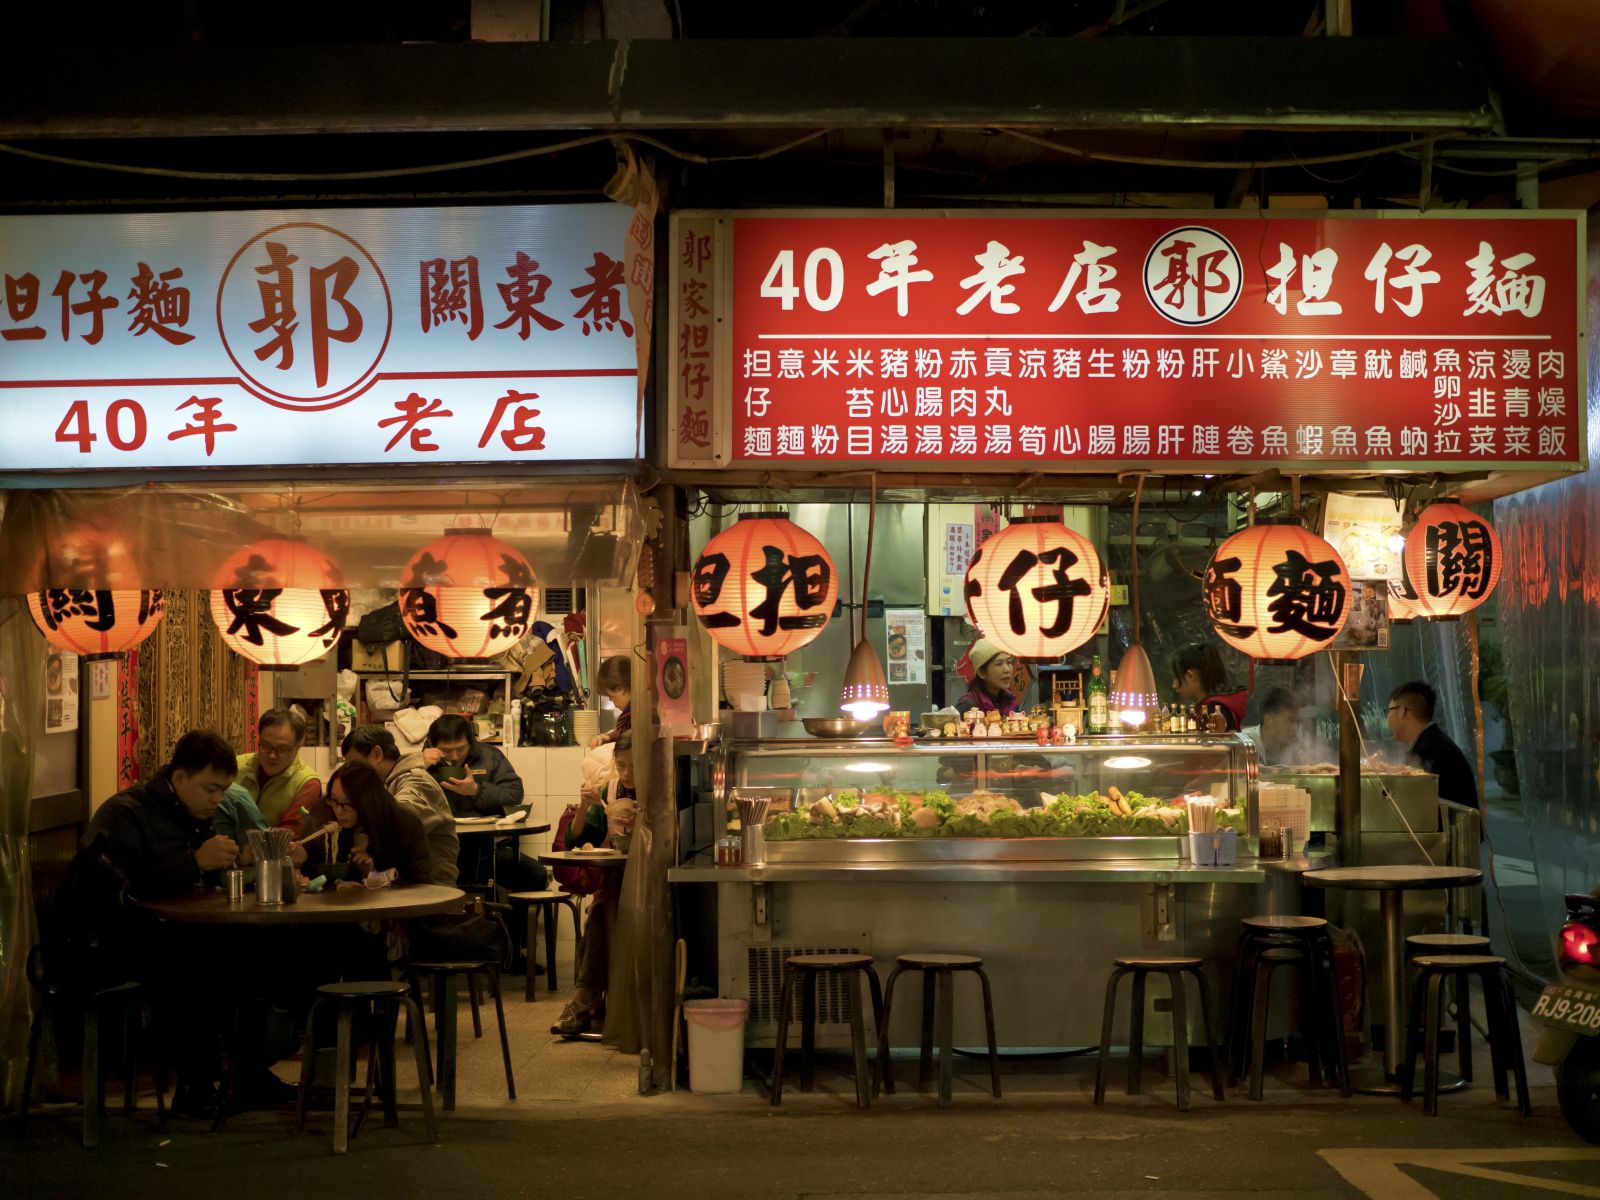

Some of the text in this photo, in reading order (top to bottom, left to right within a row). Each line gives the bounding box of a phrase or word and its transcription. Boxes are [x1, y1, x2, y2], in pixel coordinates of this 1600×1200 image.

[248, 241, 364, 389] 郭
[419, 251, 634, 341] 關東煮
[1153, 239, 1231, 318] 郭
[1265, 241, 1546, 318] 担仔麵
[680, 230, 712, 449] 郭家担仔麵
[377, 389, 547, 453] 老店
[743, 348, 773, 457] 担仔麵
[776, 347, 806, 456] 意麵
[810, 347, 840, 455] 米粉
[845, 347, 875, 455] 米苔目
[879, 347, 909, 455] 豬心湯
[914, 347, 944, 455] 粉腸湯
[949, 347, 978, 455] 赤肉湯
[983, 347, 1013, 454] 貢丸湯
[1052, 347, 1082, 455] 豬心
[1087, 347, 1116, 455] 生腸
[1122, 347, 1151, 455] 粉腸
[1156, 347, 1186, 455] 粉肝
[1226, 347, 1255, 455] 小卷
[1260, 345, 1290, 456] 鯊魚
[1295, 348, 1324, 456] 沙蝦
[1329, 348, 1359, 456] 章魚
[1363, 348, 1393, 456] 魷魚
[1433, 348, 1462, 454] 魚卵沙拉
[1467, 348, 1497, 456] 涼韭菜
[1502, 348, 1531, 456] 燙青菜
[1537, 349, 1566, 455] 肉燥飯
[750, 545, 831, 637] 担
[997, 545, 1092, 639] 仔
[1266, 549, 1346, 642] 麵
[1425, 519, 1493, 600] 關
